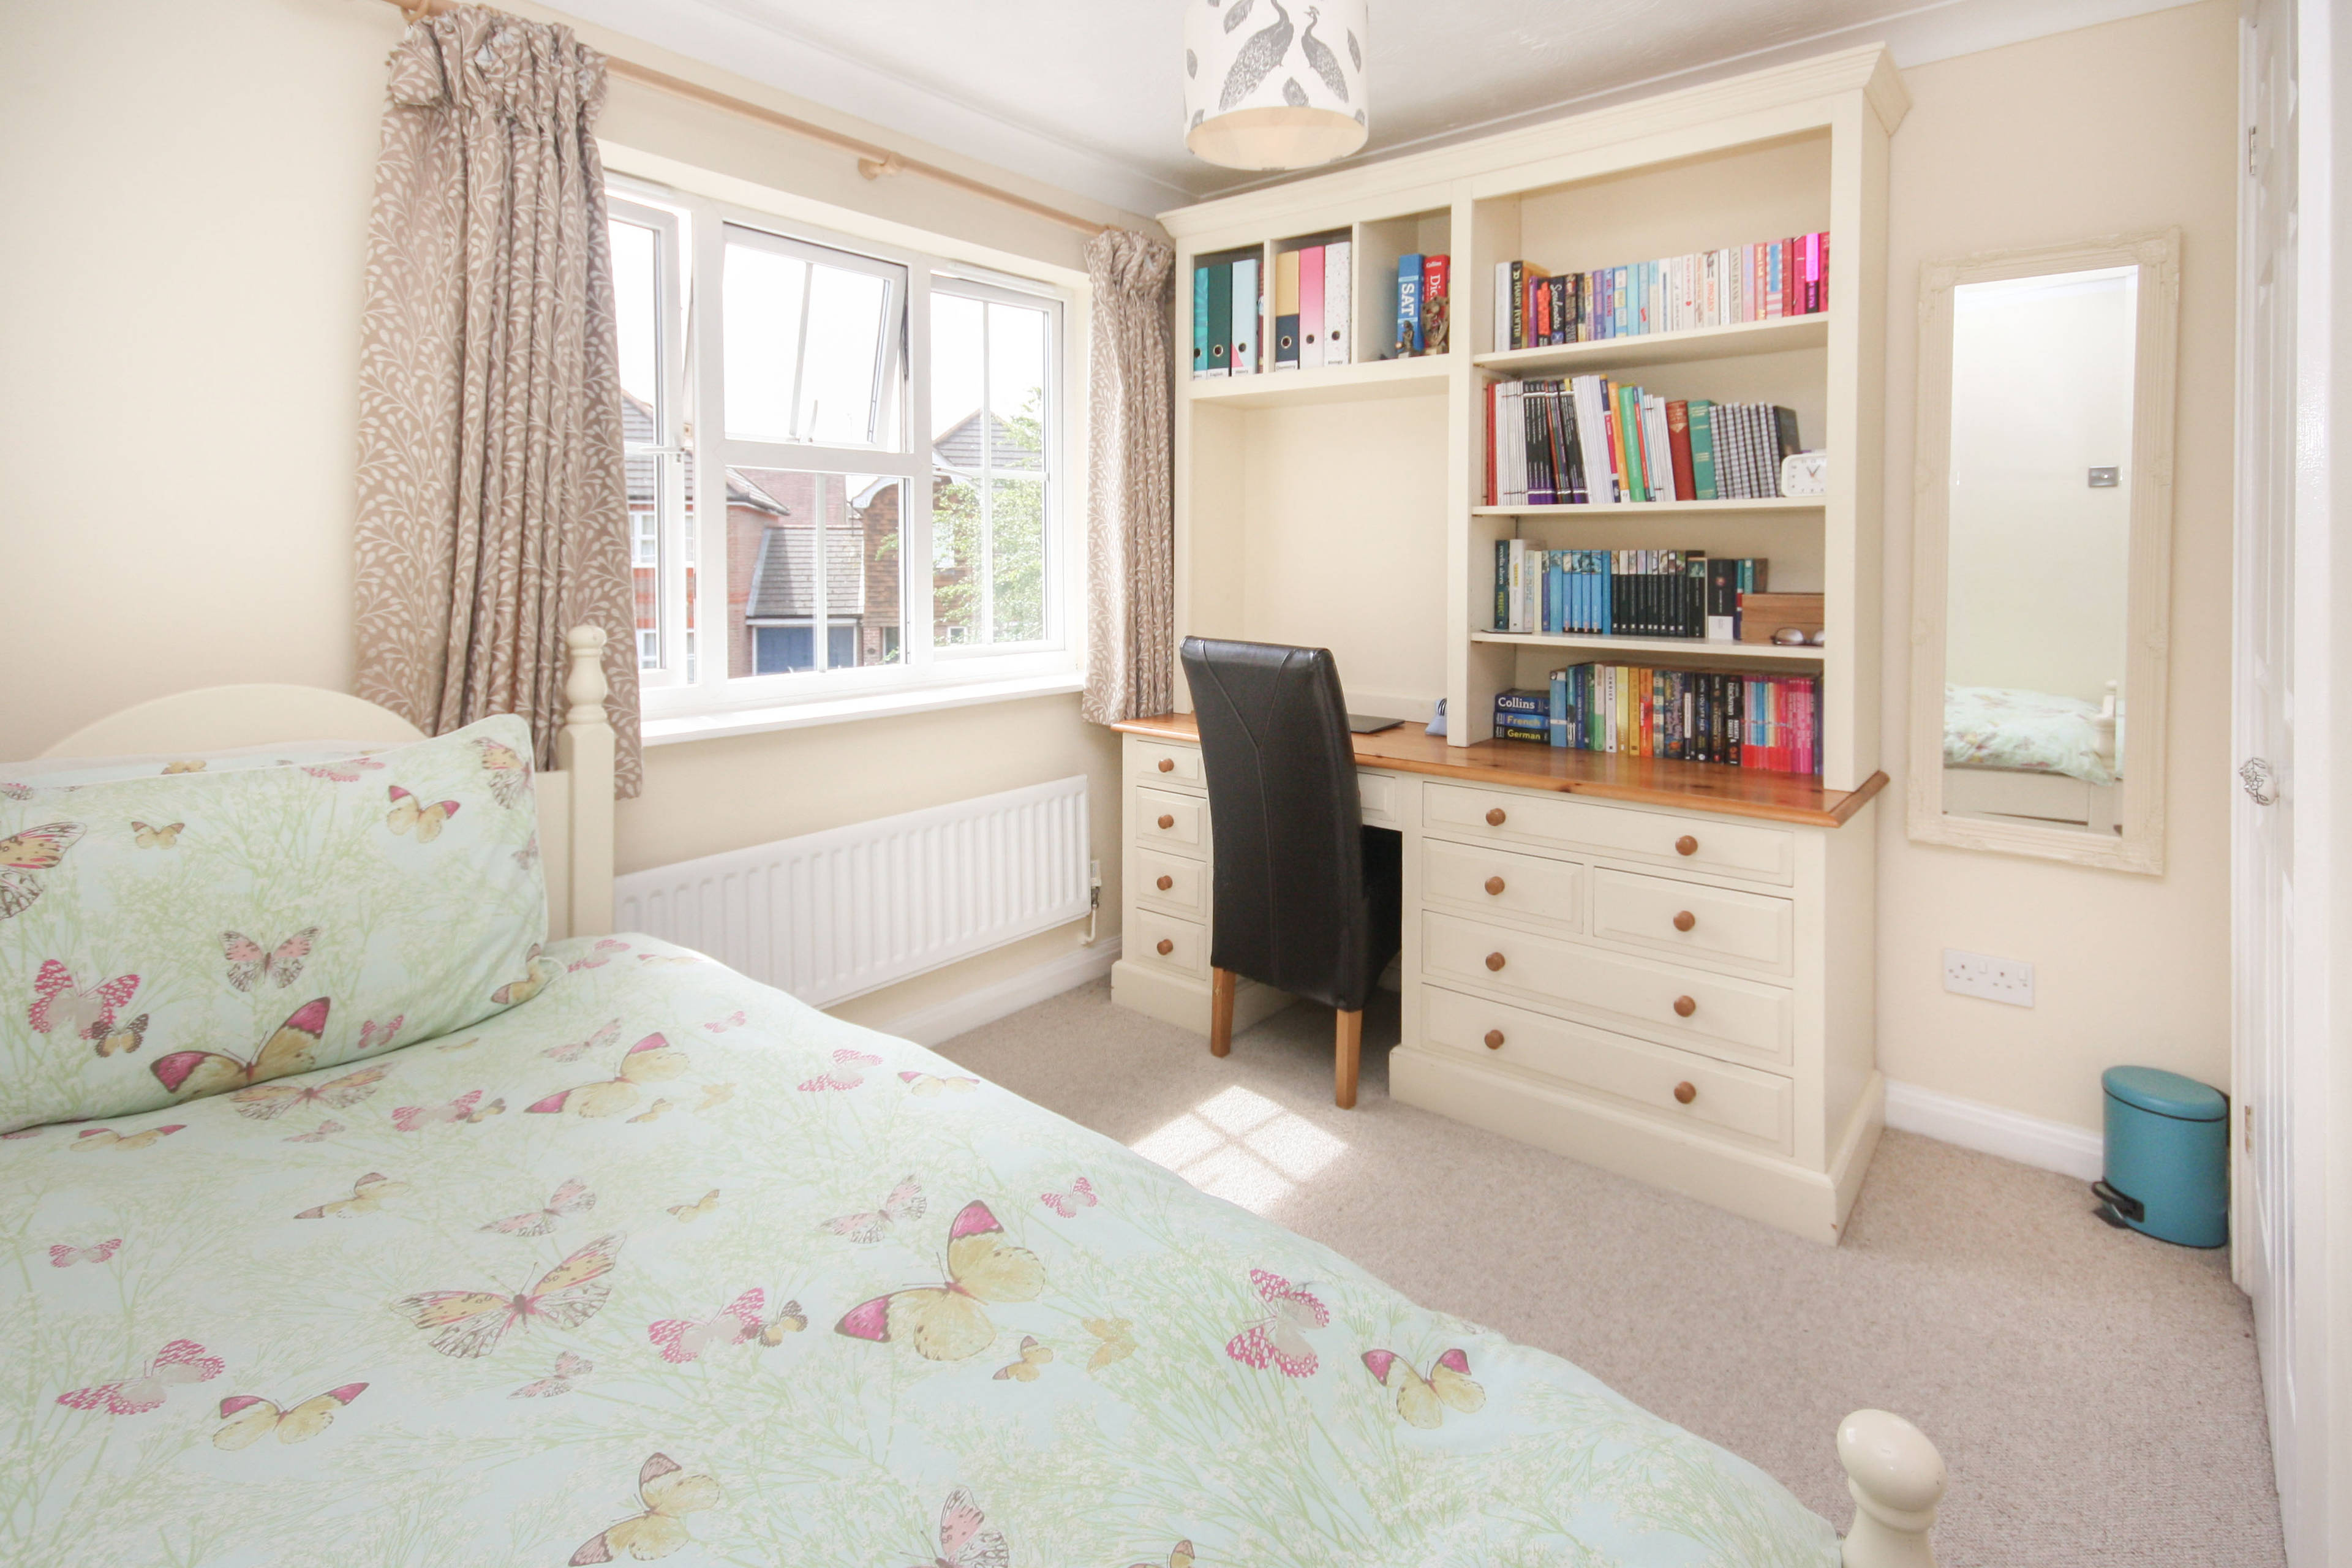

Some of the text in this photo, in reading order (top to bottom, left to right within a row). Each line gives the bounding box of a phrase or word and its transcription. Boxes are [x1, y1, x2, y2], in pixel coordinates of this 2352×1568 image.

[1498, 697, 1536, 709] Collins
[1507, 715, 1541, 727] French
[1507, 729, 1541, 740] German
